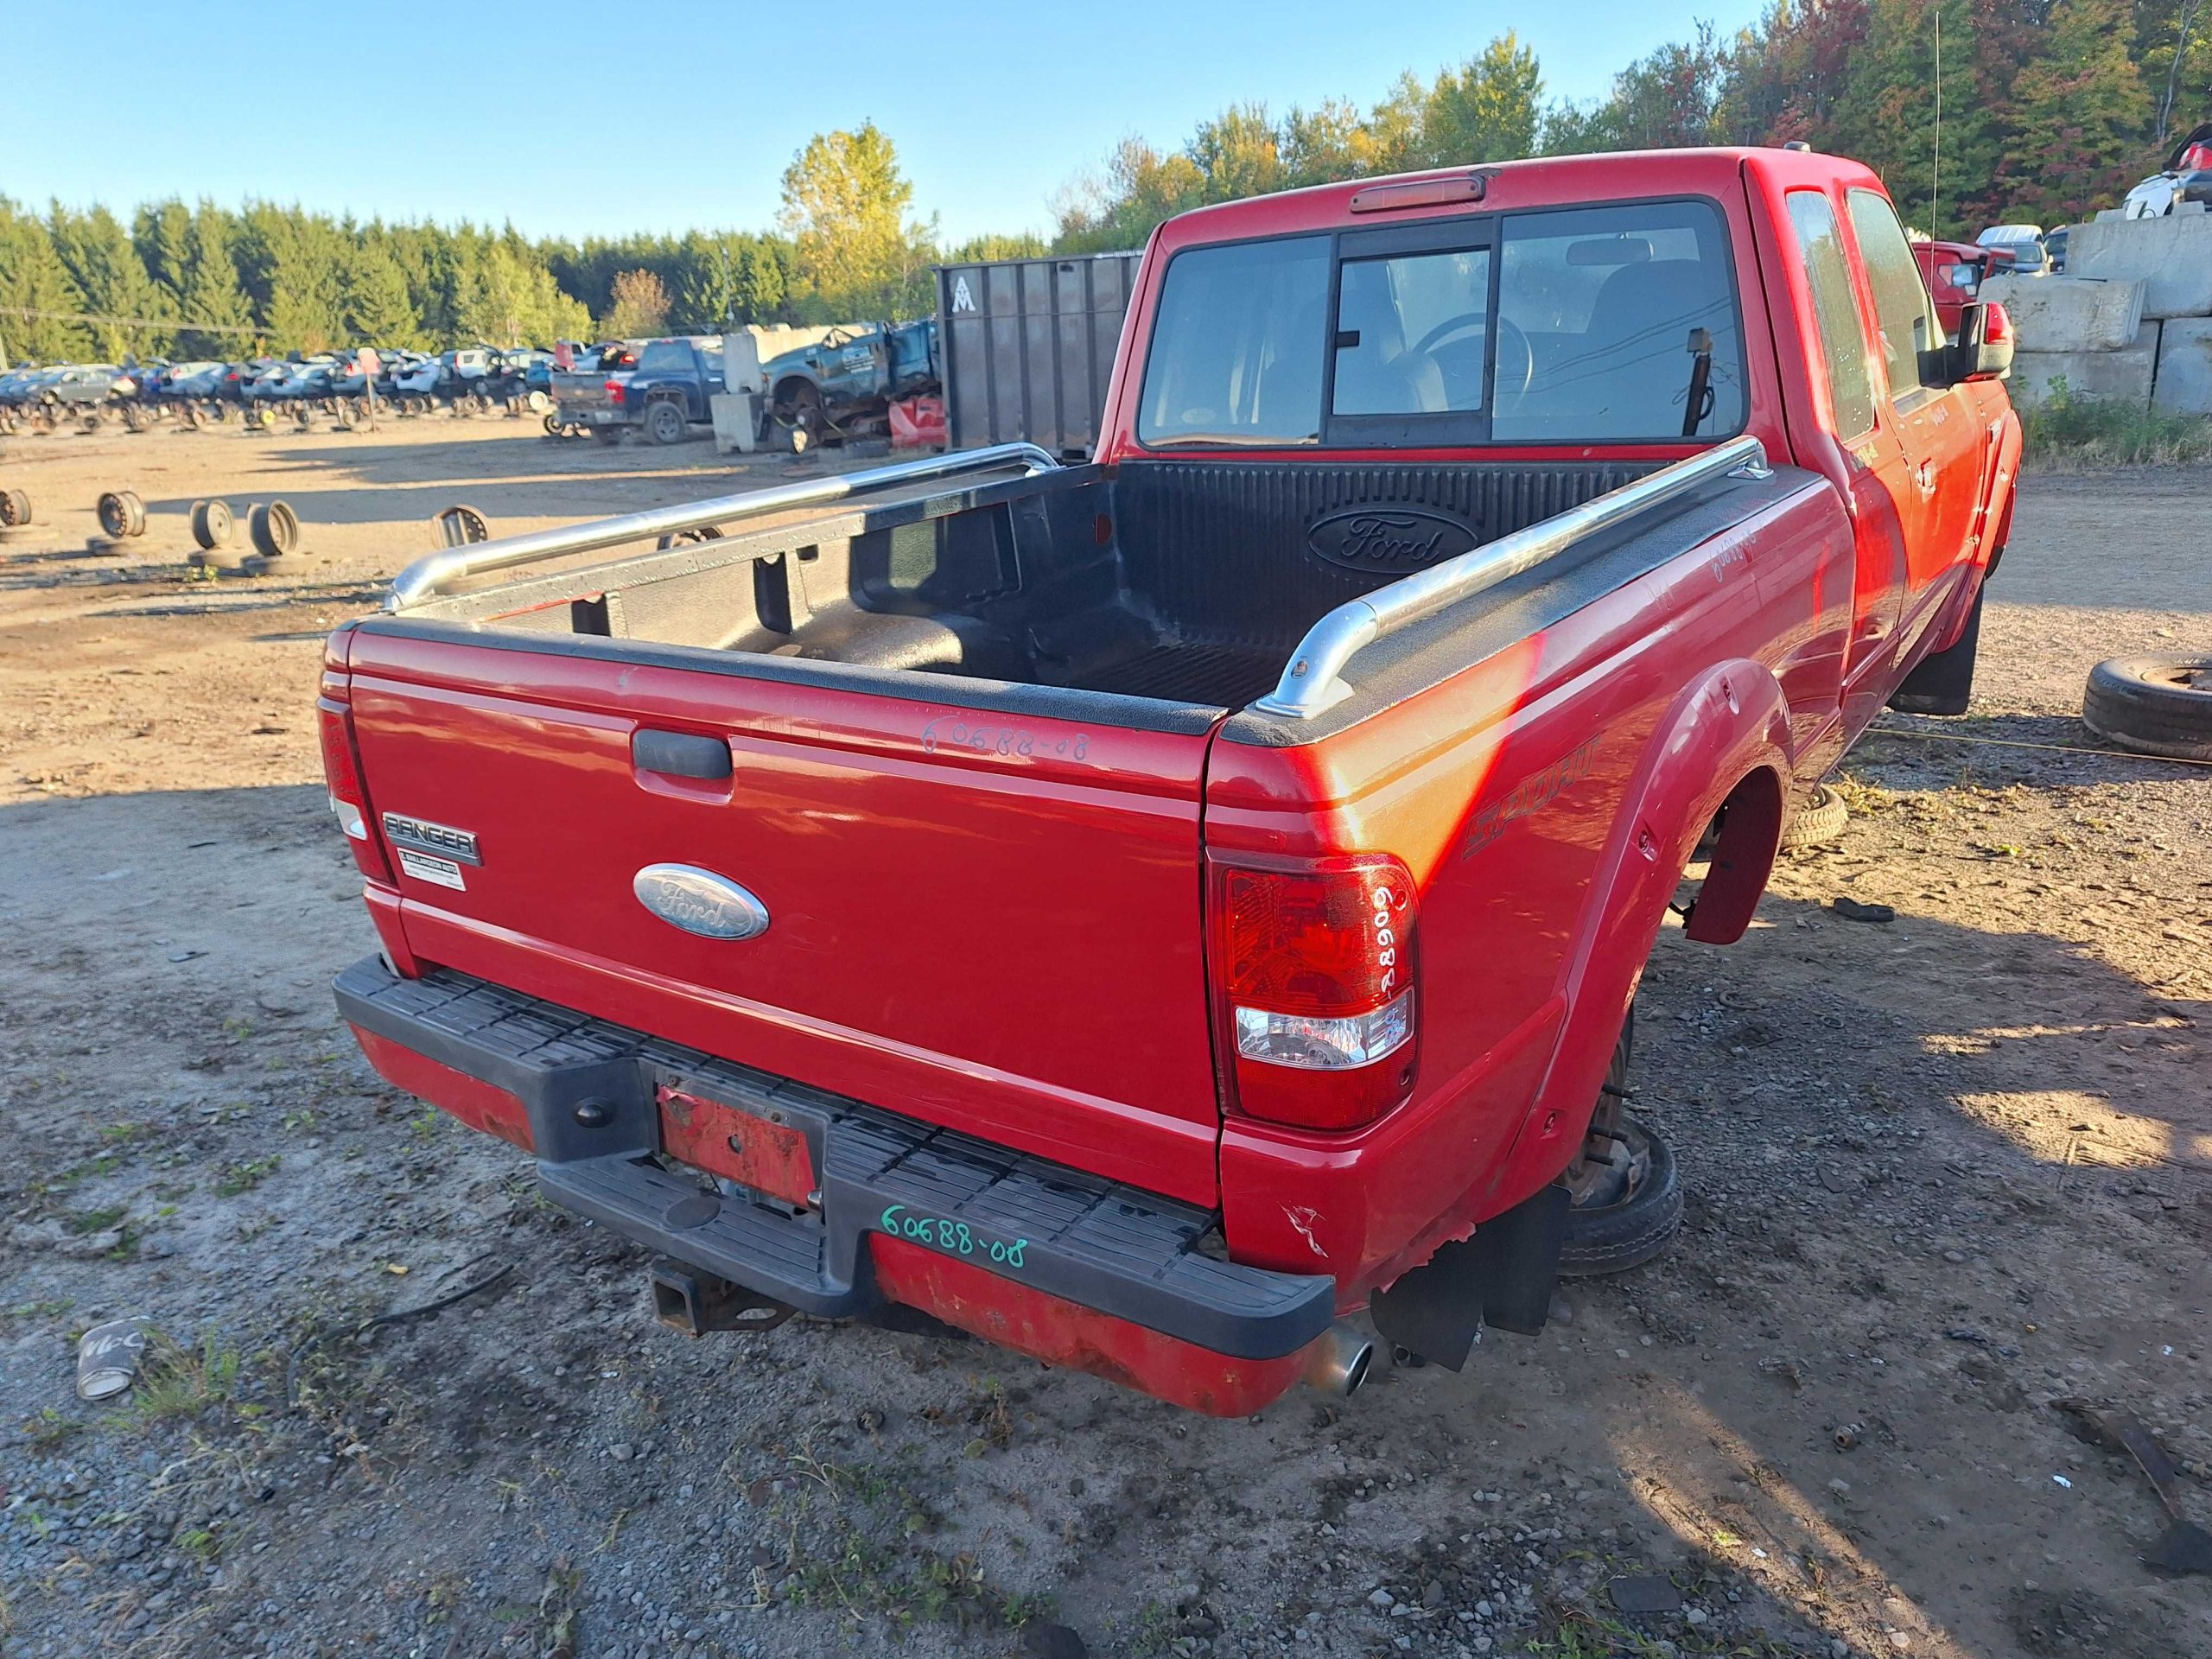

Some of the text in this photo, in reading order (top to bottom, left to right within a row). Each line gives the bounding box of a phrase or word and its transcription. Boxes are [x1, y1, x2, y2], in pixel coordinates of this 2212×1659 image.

[1341, 517, 1444, 561] Ford
[920, 715, 1090, 761] 60688-08
[385, 816, 474, 854] RANGER
[657, 879, 726, 928] Ford
[881, 1204, 1028, 1268] 60688-08
